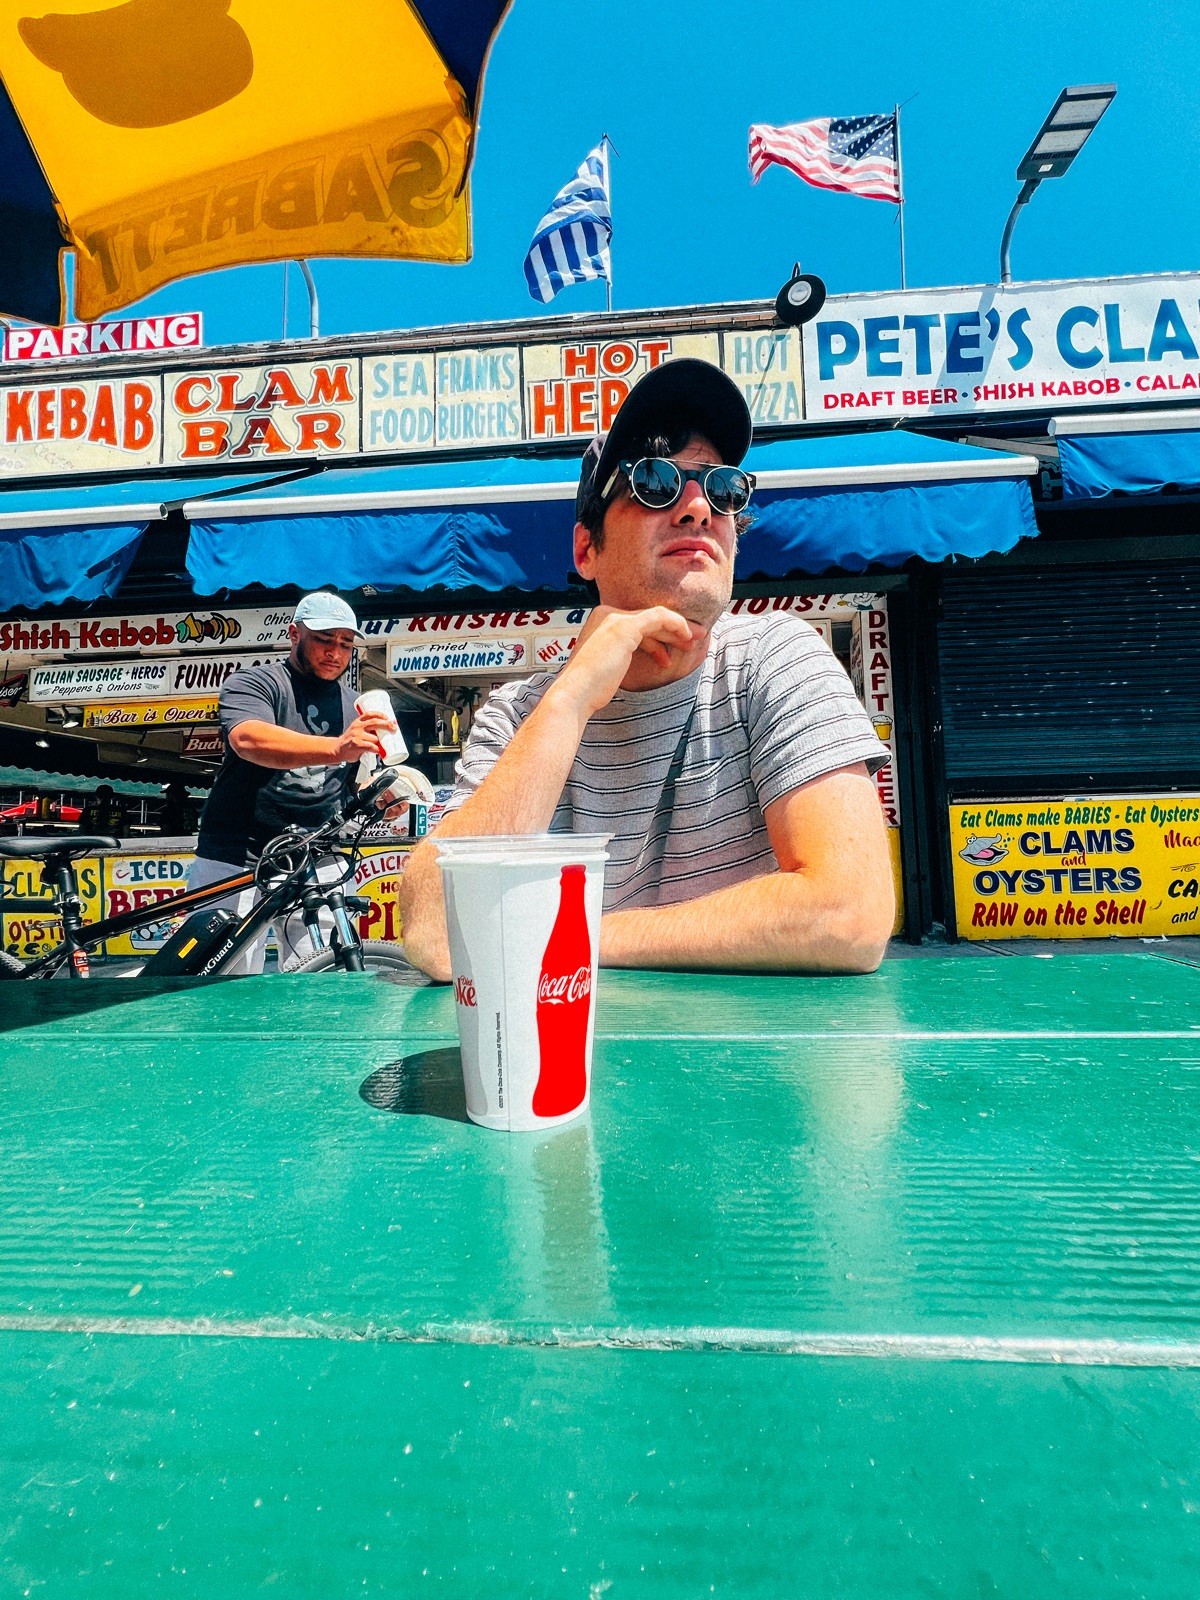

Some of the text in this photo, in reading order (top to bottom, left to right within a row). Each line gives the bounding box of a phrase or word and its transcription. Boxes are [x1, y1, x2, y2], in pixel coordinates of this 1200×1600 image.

[10, 316, 197, 358] PARKING
[816, 298, 1200, 381] PETE'S CLA
[564, 342, 669, 377] HOT
[734, 334, 791, 374] HOT
[174, 366, 354, 413] CLAM
[373, 360, 428, 398] SEA
[439, 353, 515, 394] FRANKS
[745, 381, 800, 422] IZZA
[824, 374, 1200, 409] DRAFT BEER SHISH KABOB CALA
[6, 382, 153, 450] KEBAB
[370, 407, 433, 445] FOOD
[438, 402, 519, 440] BURGERS
[181, 412, 343, 458] BAR
[0, 618, 175, 650] Shish Kabob
[357, 618, 399, 635] ur
[408, 609, 555, 632] KNISHES
[393, 651, 504, 672] JUMBO SHRIMPS
[429, 642, 468, 652] Fried
[868, 610, 890, 711] DRAFT
[34, 669, 73, 685] ITALIAN
[75, 667, 124, 683] SAUSAGE
[131, 665, 167, 680] HEROS
[52, 685, 92, 695] Peppers
[107, 682, 142, 692] Onions
[174, 662, 241, 689] FUNNE
[103, 707, 206, 724] Bar is Open
[877, 744, 900, 826] EER
[960, 811, 981, 828] Eat
[985, 809, 1023, 827] Clams
[1026, 808, 1060, 826] make
[1064, 806, 1111, 825] BABIES
[1124, 805, 1147, 823] Eat
[1150, 804, 1200, 828] Oysters
[1018, 828, 1135, 857] CLAMS
[1061, 850, 1087, 867] and
[130, 860, 184, 882] ICED
[973, 867, 1142, 895] OYSTERS
[381, 881, 400, 894] HO
[1168, 879, 1200, 898] CA
[359, 901, 405, 941] PI
[972, 900, 1147, 928] RAW on the Shell
[1172, 906, 1199, 924] and
